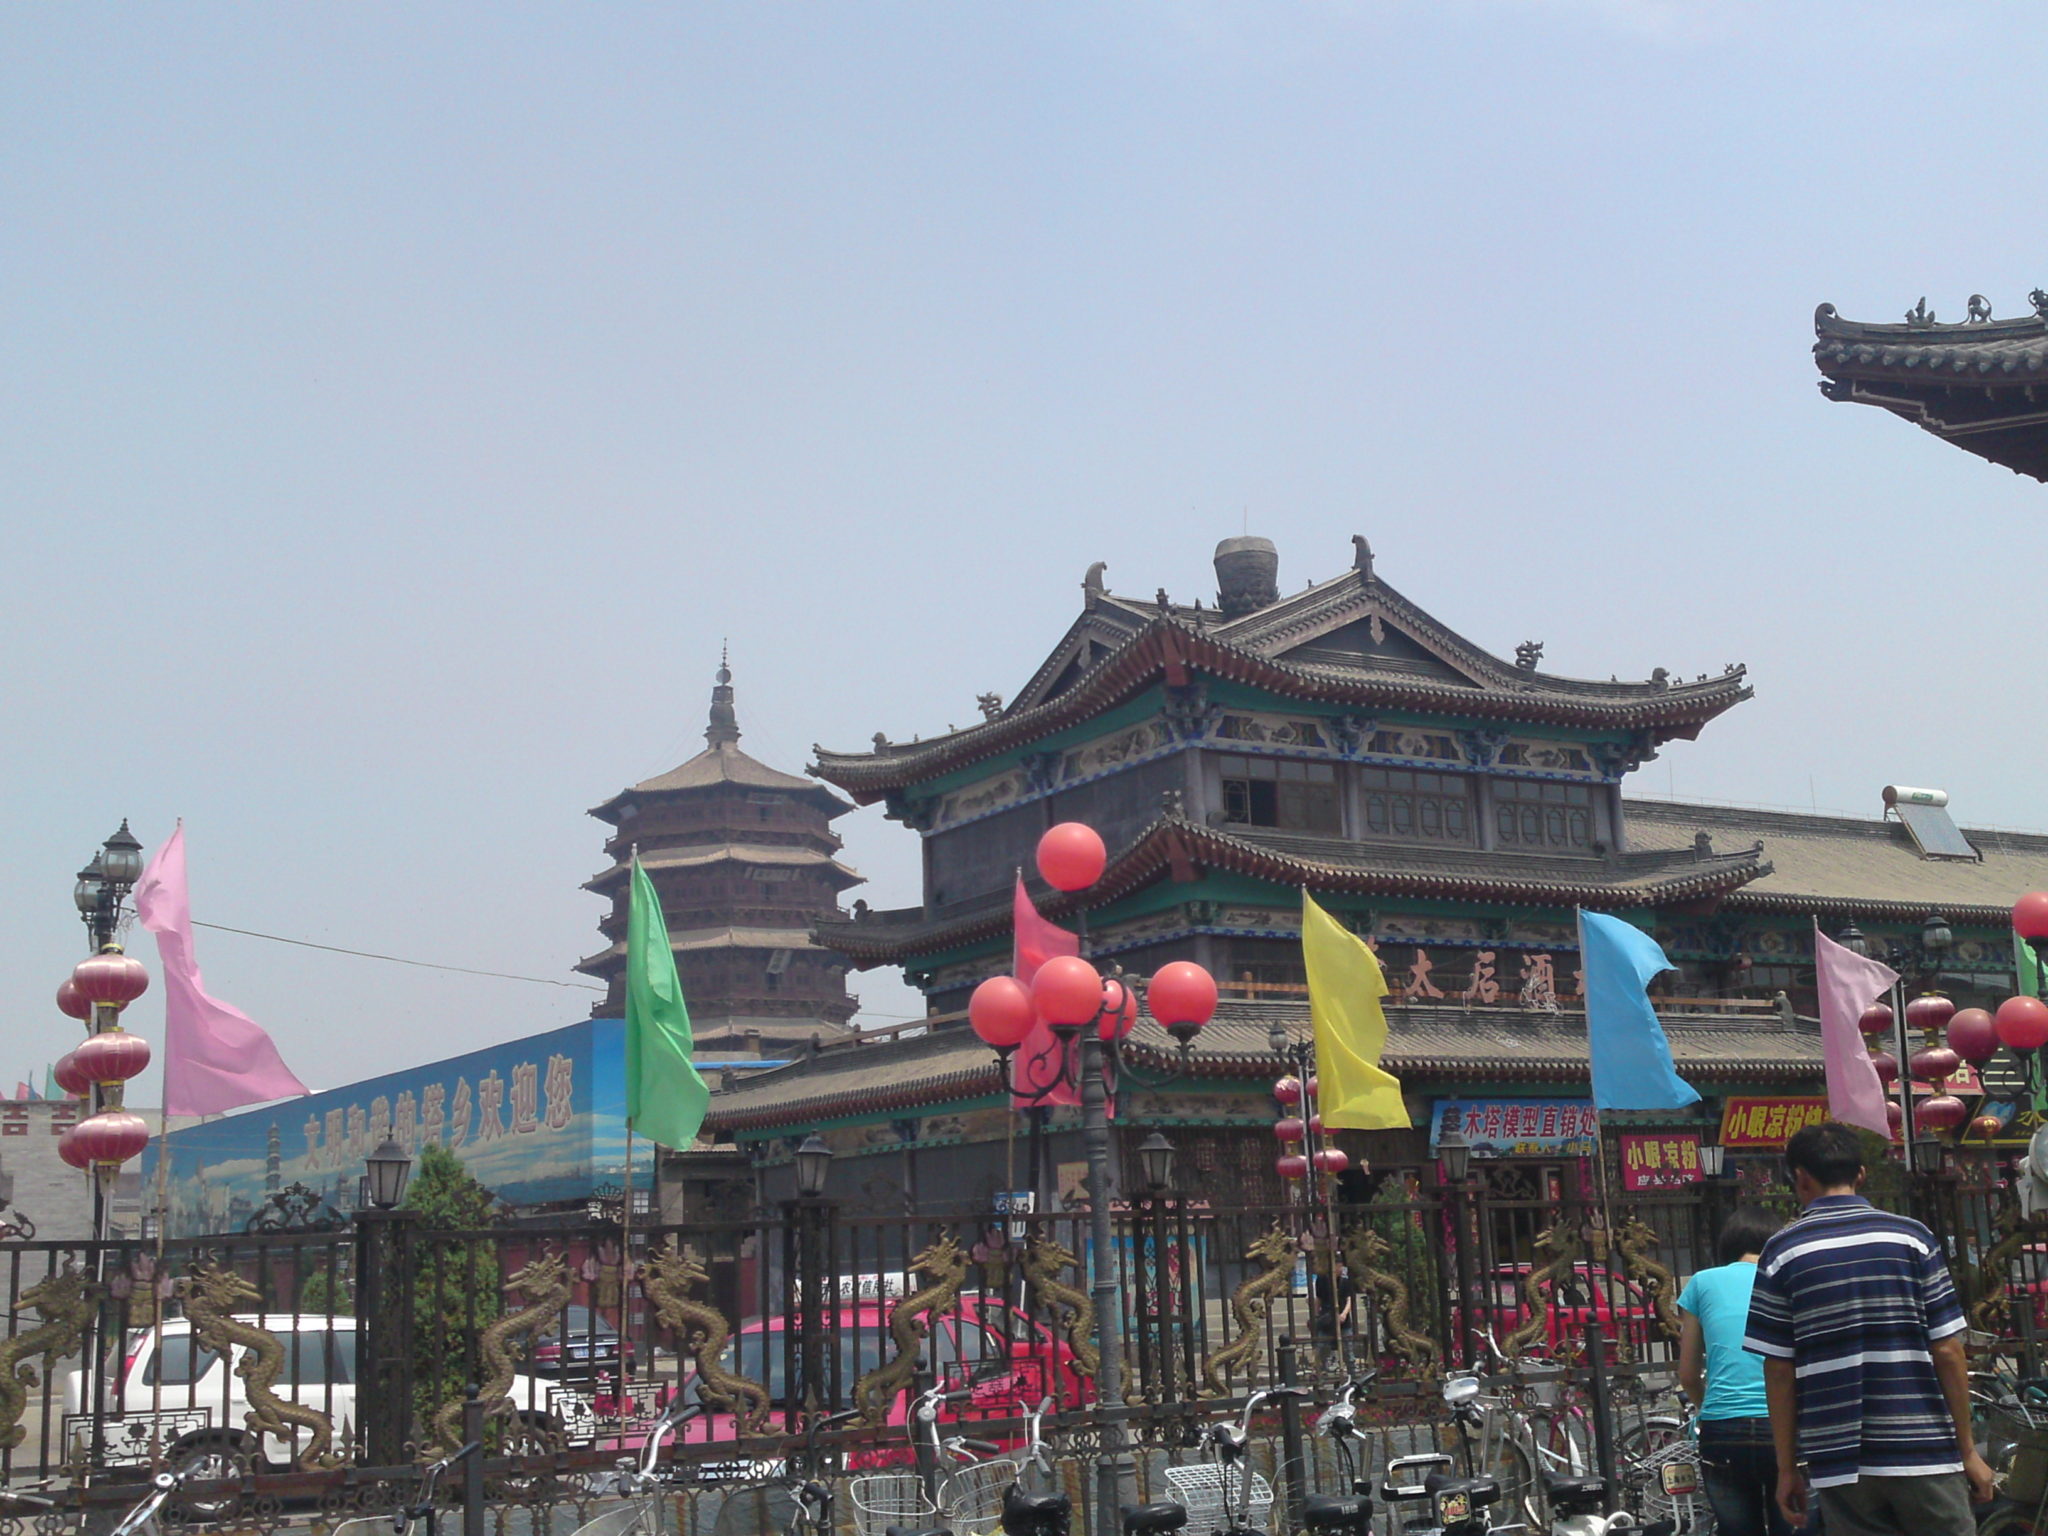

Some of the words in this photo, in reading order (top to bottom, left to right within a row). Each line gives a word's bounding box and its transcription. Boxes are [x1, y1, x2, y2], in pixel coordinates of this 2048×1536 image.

[1366, 935, 1585, 1009] 太后酒
[304, 1053, 573, 1170] 文明和谐的塔乡欢迎您
[1464, 1104, 1596, 1138] 木塔模型直销处
[1627, 1140, 1697, 1170] 小眼凉粉
